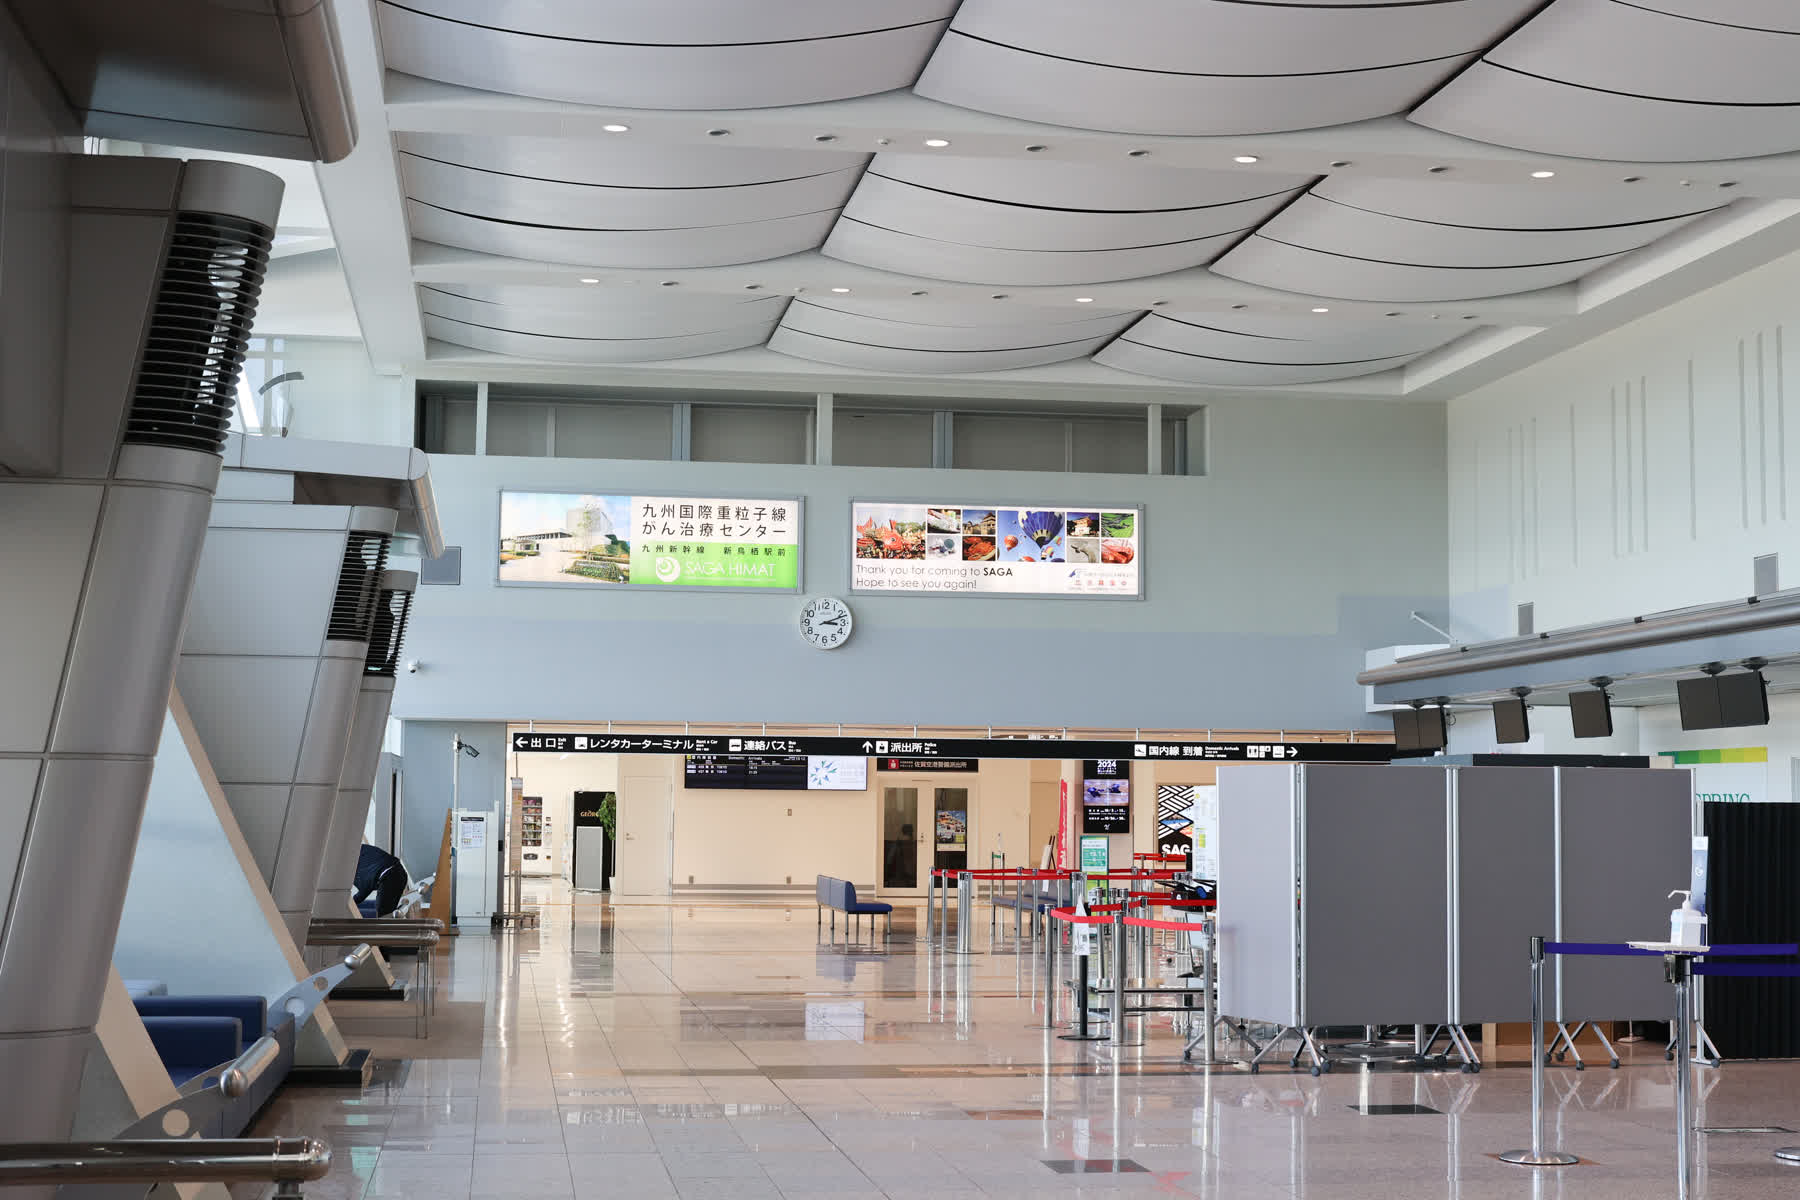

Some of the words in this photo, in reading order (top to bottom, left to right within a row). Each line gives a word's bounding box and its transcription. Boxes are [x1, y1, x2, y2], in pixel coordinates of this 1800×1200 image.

[642, 503, 786, 521] 九州国際重粒子線
[642, 521, 786, 537] がん治療センター
[686, 561, 725, 575] SAGA
[729, 562, 776, 577] HIMAT
[856, 565, 886, 575] Thank
[890, 567, 908, 577] you
[911, 565, 924, 575] for
[928, 566, 967, 577] coming
[970, 567, 980, 576] to
[983, 567, 1013, 577] SAGA
[856, 577, 884, 588] Hope
[888, 579, 898, 588] to
[901, 580, 919, 588] see
[921, 580, 941, 589] you
[943, 579, 976, 590] again!
[805, 610, 814, 618] 10
[840, 619, 846, 627] 3
[814, 633, 820, 641] 7
[822, 636, 828, 644] 6
[831, 633, 837, 641] 5
[531, 737, 556, 748] 出口
[590, 738, 694, 750] レンタカーターミナル
[744, 740, 787, 751] 連絡バス
[890, 742, 923, 753] 派出所
[1149, 745, 1180, 756] 国内線
[1182, 745, 1203, 757] 到着
[1097, 760, 1117, 768] 2024
